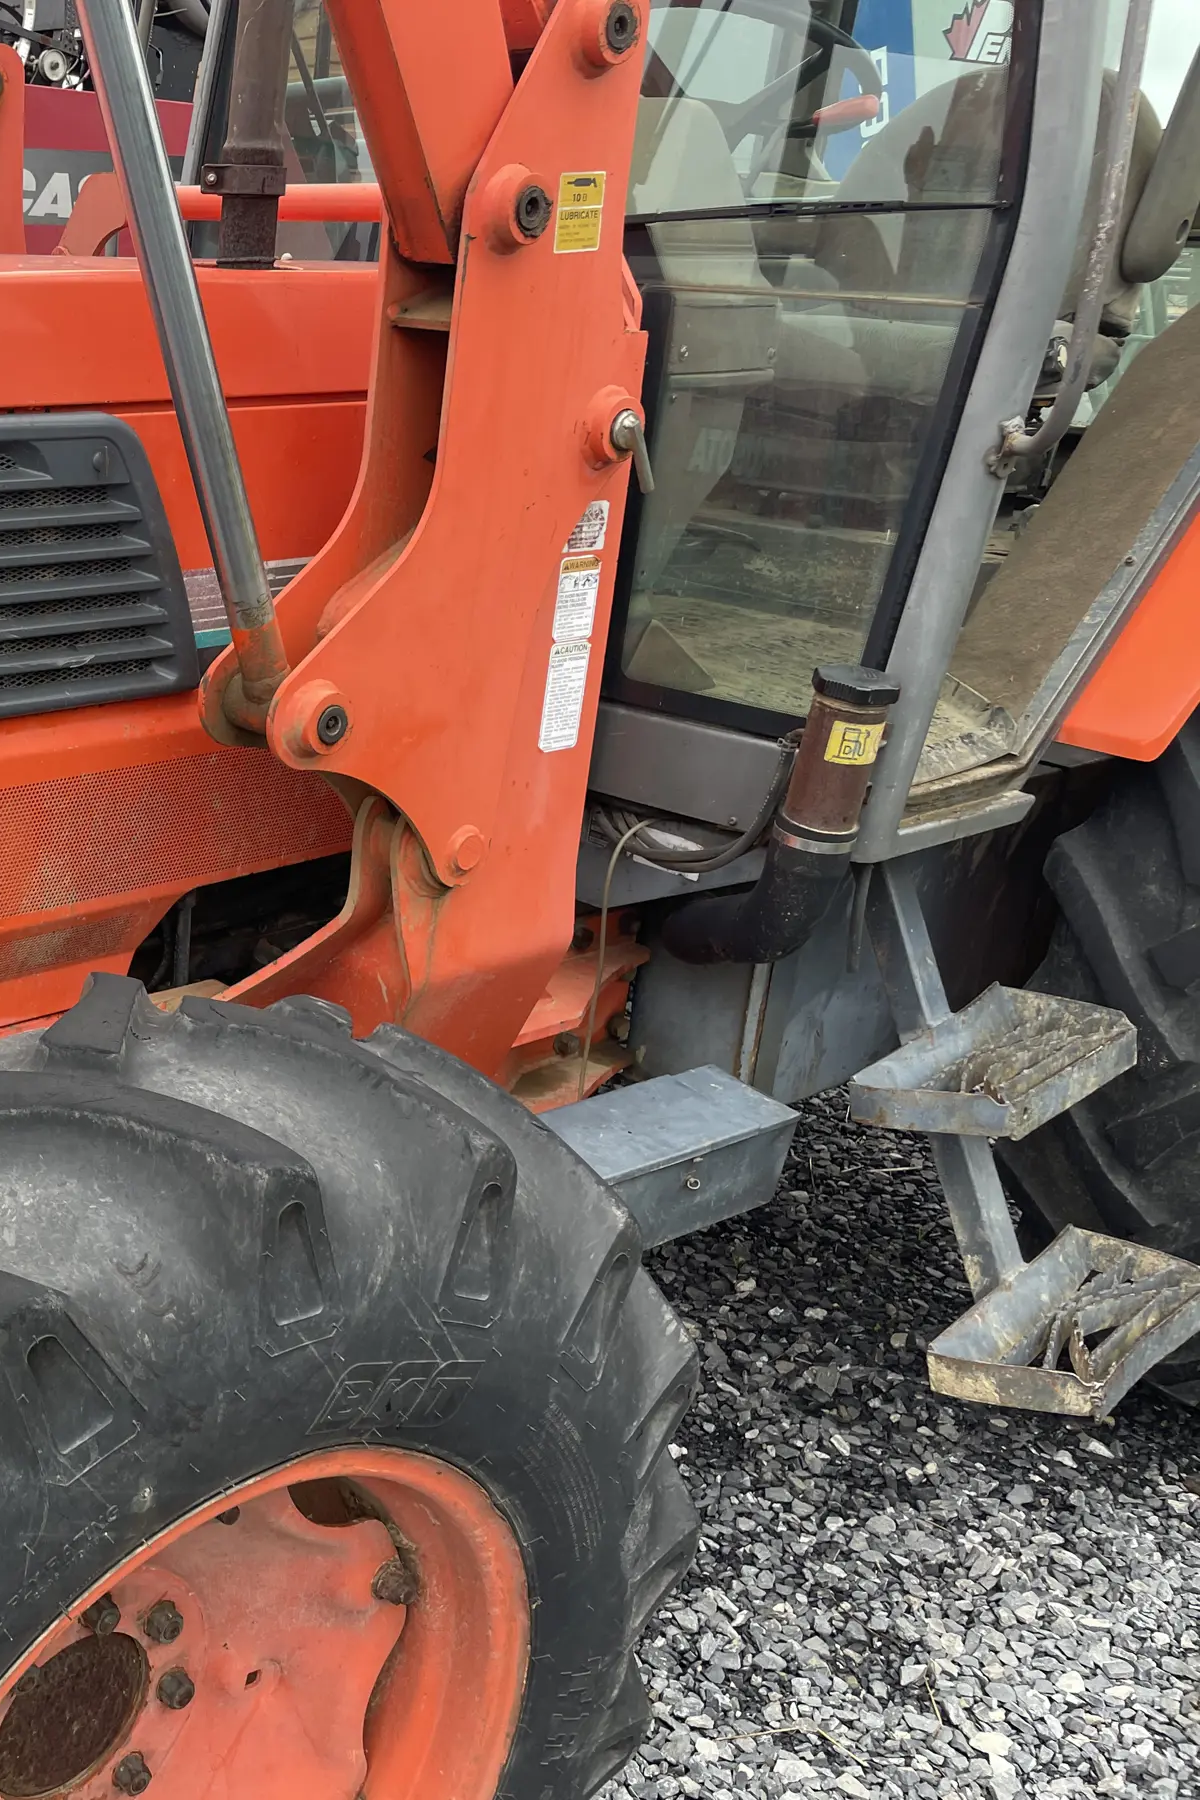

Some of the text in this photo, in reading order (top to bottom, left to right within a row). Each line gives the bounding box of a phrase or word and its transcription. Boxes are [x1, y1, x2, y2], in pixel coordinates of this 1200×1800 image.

[560, 211, 598, 220] LUBRICATE
[569, 559, 598, 569] WARNING
[560, 644, 588, 654] CAUTION
